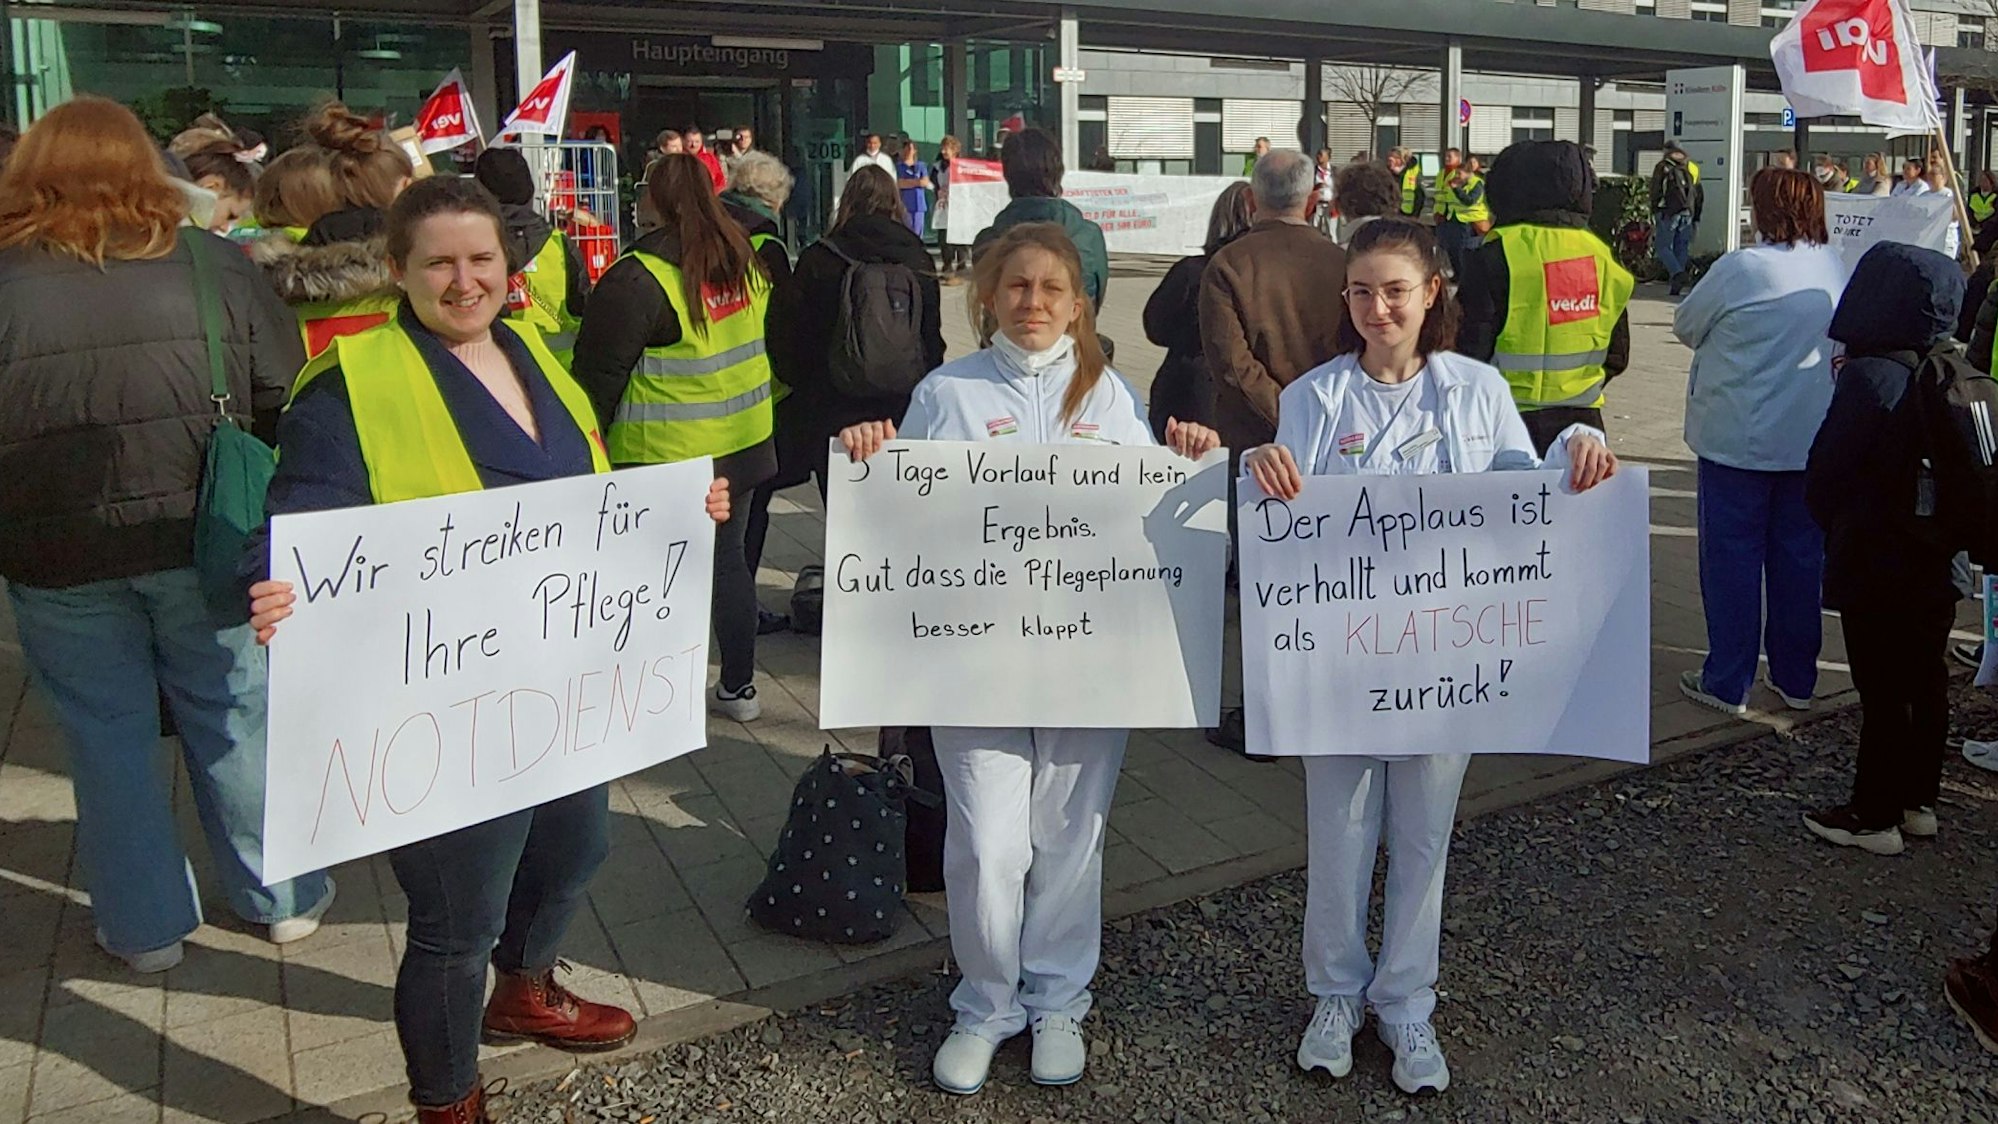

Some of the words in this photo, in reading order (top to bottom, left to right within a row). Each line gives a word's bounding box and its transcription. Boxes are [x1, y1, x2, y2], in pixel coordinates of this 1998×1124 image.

[632, 39, 789, 69] Haupteingang
[1550, 294, 1596, 312] ver.di
[887, 448, 949, 496] Tage
[967, 449, 1058, 486] Vorlauf
[1073, 461, 1120, 486] und
[1139, 458, 1188, 486] kein
[292, 535, 389, 603] Wir
[420, 501, 563, 581] streiken
[596, 481, 651, 552] für
[983, 504, 1097, 553] Ergebnis.
[1255, 497, 1331, 543] Der
[1348, 486, 1485, 552] Applaus
[1511, 482, 1553, 526] ist
[837, 553, 895, 593] Gut
[906, 555, 966, 588] dass
[974, 558, 1008, 586] die
[1024, 557, 1183, 593] Pflegeplanung
[1256, 556, 1377, 608] verhallt
[1394, 548, 1447, 597] und
[1462, 540, 1552, 587] kommt
[404, 608, 500, 685] Ihre
[532, 540, 689, 653] Pflege!
[912, 612, 996, 639] besser
[1021, 611, 1093, 640] klappt
[1274, 619, 1316, 652] als
[1346, 599, 1547, 655] KLATSCHE
[1370, 659, 1513, 712] zurück!
[310, 644, 702, 846] NOTDIENST
